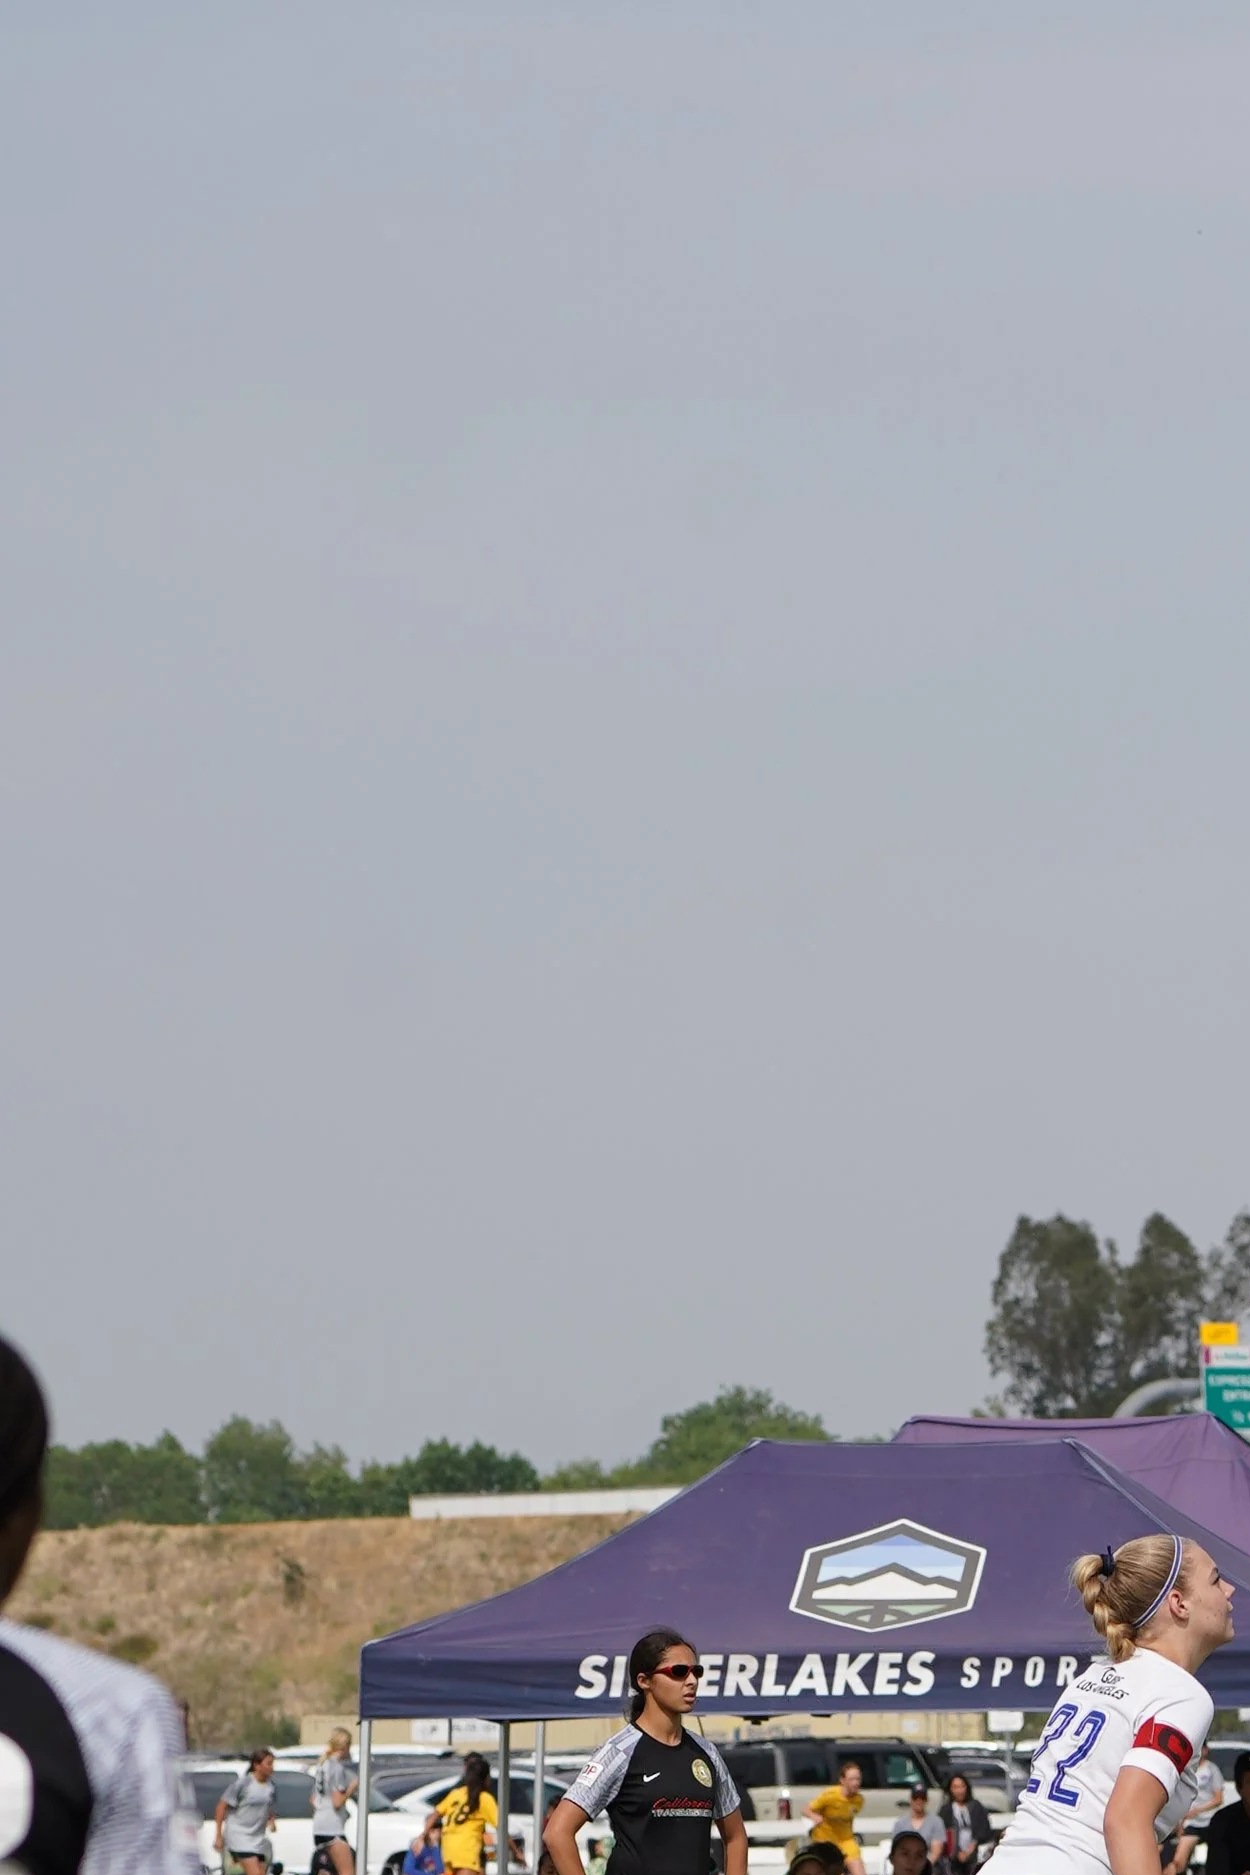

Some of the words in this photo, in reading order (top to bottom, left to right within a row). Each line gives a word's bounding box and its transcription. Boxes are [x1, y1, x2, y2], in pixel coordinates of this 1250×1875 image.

[574, 1650, 937, 1699] SIERLAKES
[1076, 1679, 1097, 1692] LOS
[1027, 1703, 1106, 1807] 22
[1158, 1728, 1187, 1765] C
